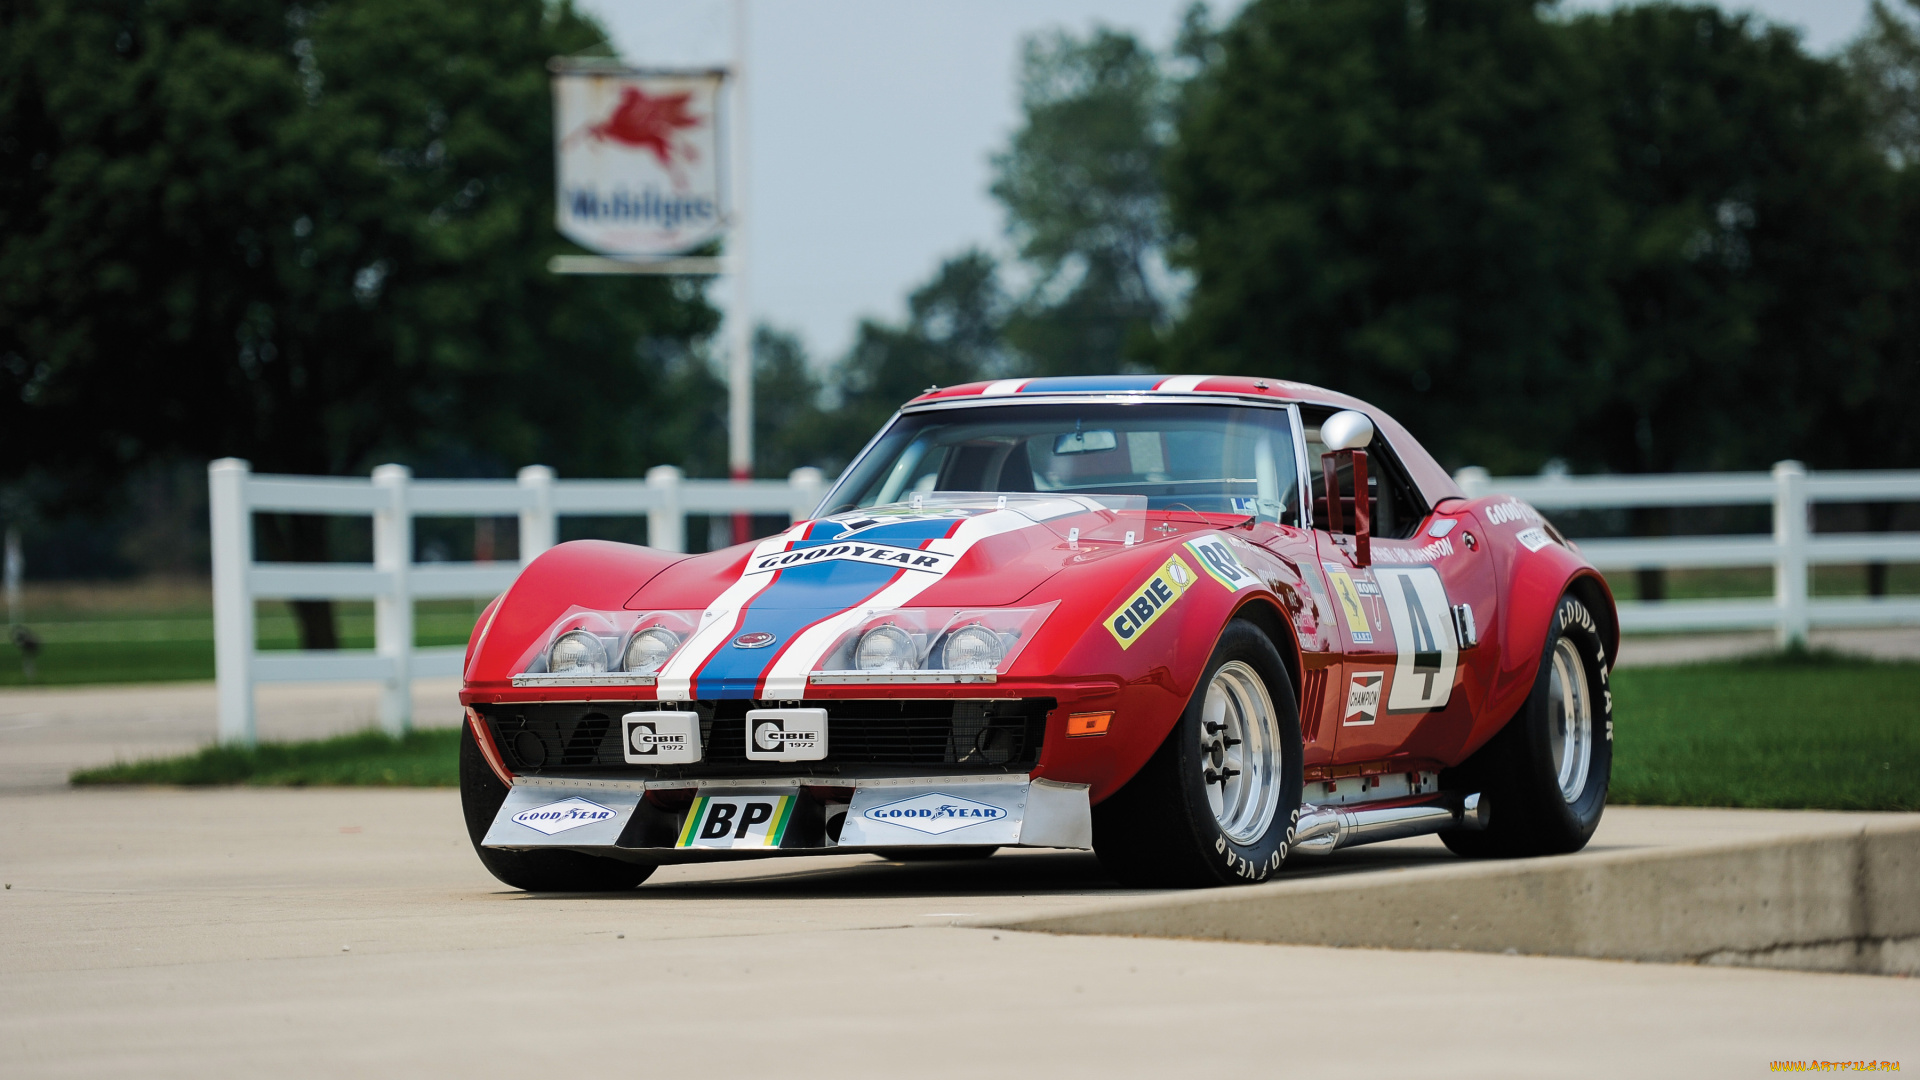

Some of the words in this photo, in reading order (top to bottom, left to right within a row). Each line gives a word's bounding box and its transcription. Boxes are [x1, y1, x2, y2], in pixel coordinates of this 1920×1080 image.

[758, 545, 940, 569] GOODYEAR
[1198, 542, 1250, 582] BP
[1356, 582, 1379, 595] KONI
[1113, 577, 1174, 640] CIBIE
[1397, 574, 1442, 701] 4
[1349, 691, 1379, 707] CHAMPION
[642, 735, 684, 743] CIBIE
[767, 732, 815, 740] CIBIE
[700, 802, 773, 840] BP
